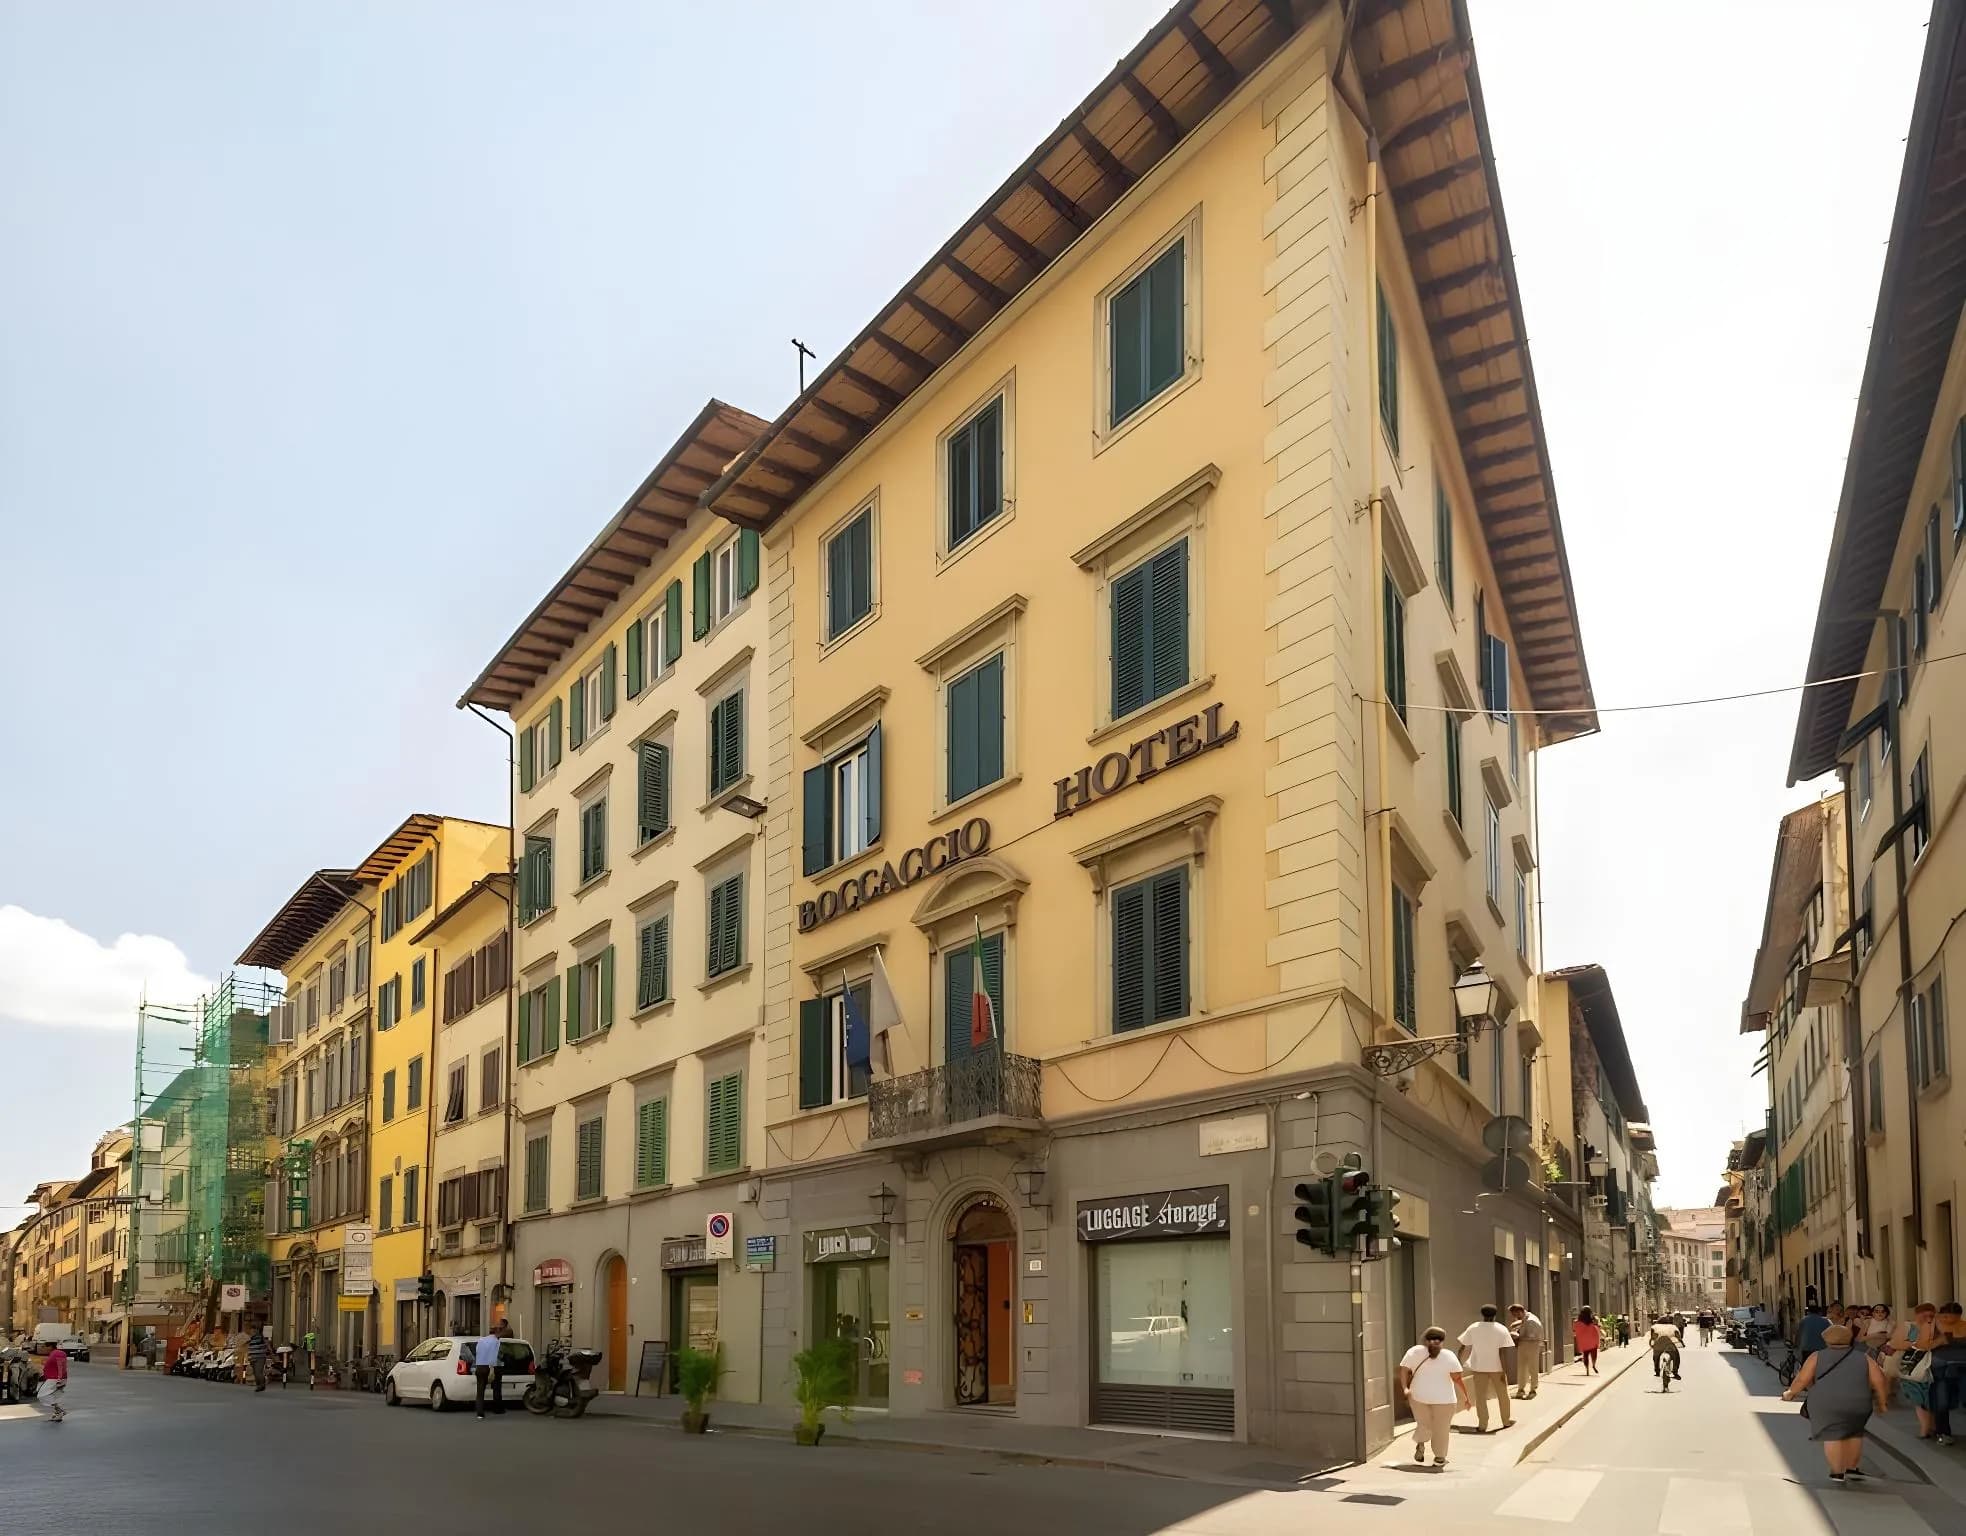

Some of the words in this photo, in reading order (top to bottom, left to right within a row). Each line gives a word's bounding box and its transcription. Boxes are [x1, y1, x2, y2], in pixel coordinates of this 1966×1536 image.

[798, 817, 991, 933] BOCCACCIO
[1053, 702, 1240, 819] HOTEL
[1087, 1204, 1150, 1231] LUGGAGE
